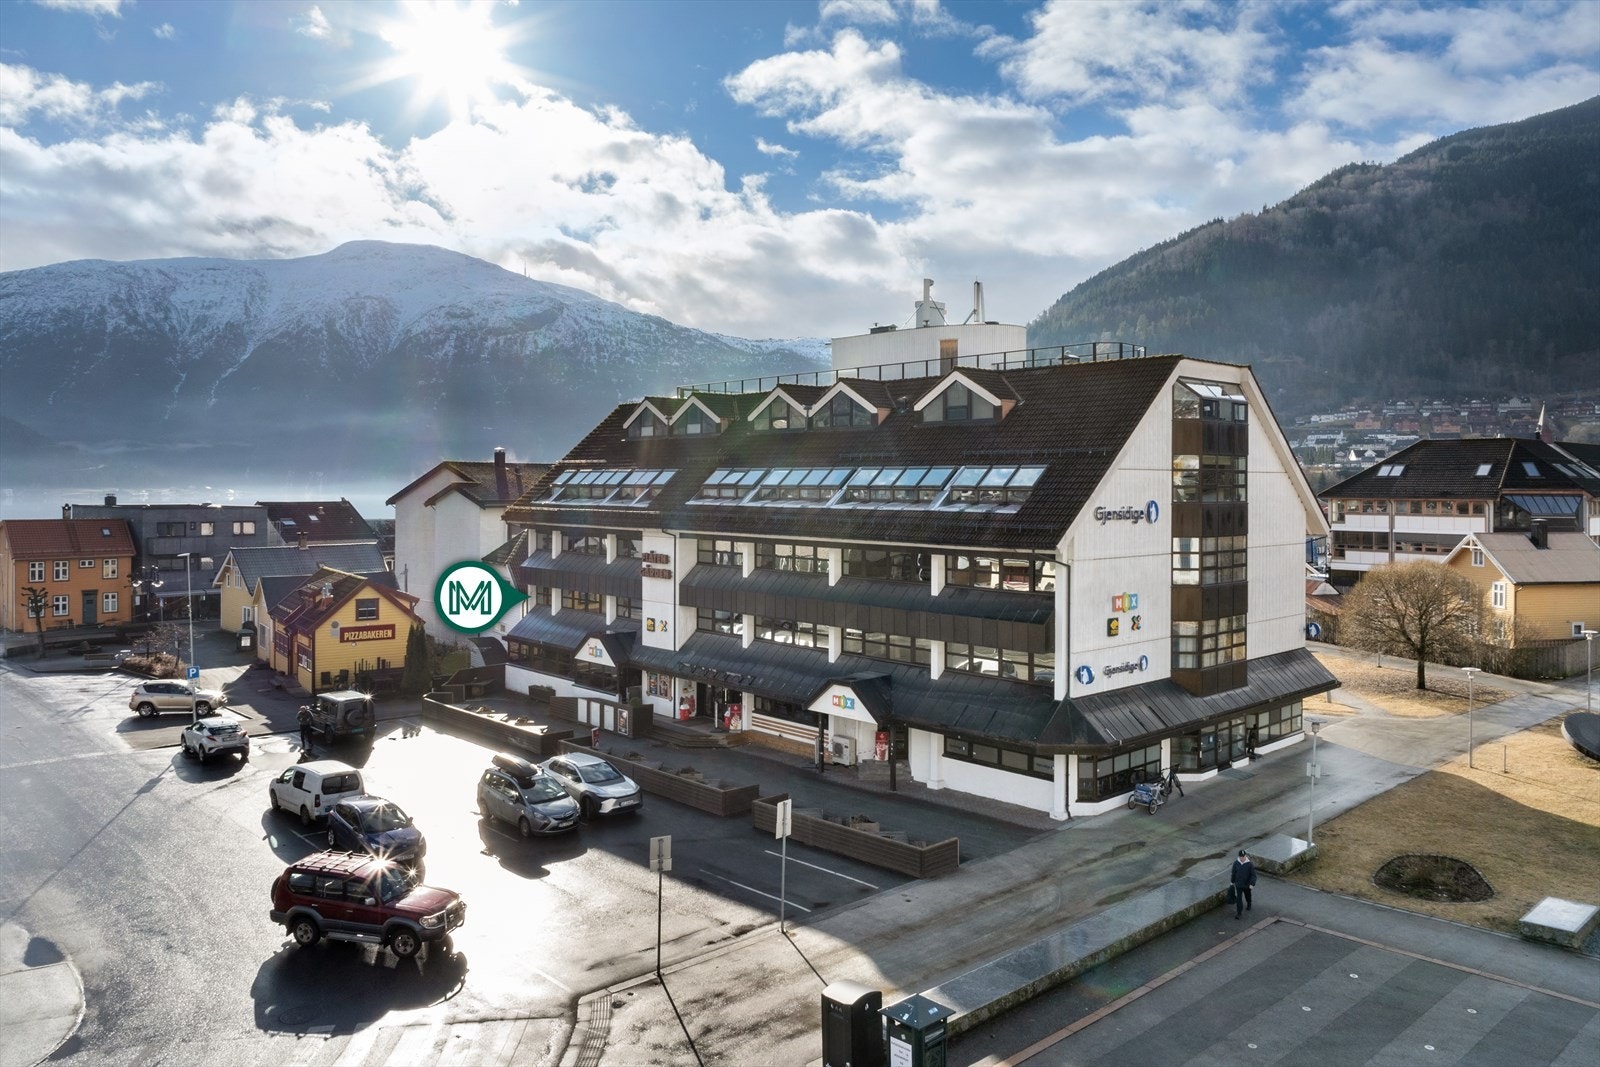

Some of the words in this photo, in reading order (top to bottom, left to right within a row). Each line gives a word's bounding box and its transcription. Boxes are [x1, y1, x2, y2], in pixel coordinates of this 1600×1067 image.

[1094, 506, 1145, 525] Gjensidige
[1114, 595, 1138, 610] MIX
[344, 630, 392, 640] PIZZABAKEREN
[189, 668, 197, 677] P
[832, 695, 853, 708] MIX
